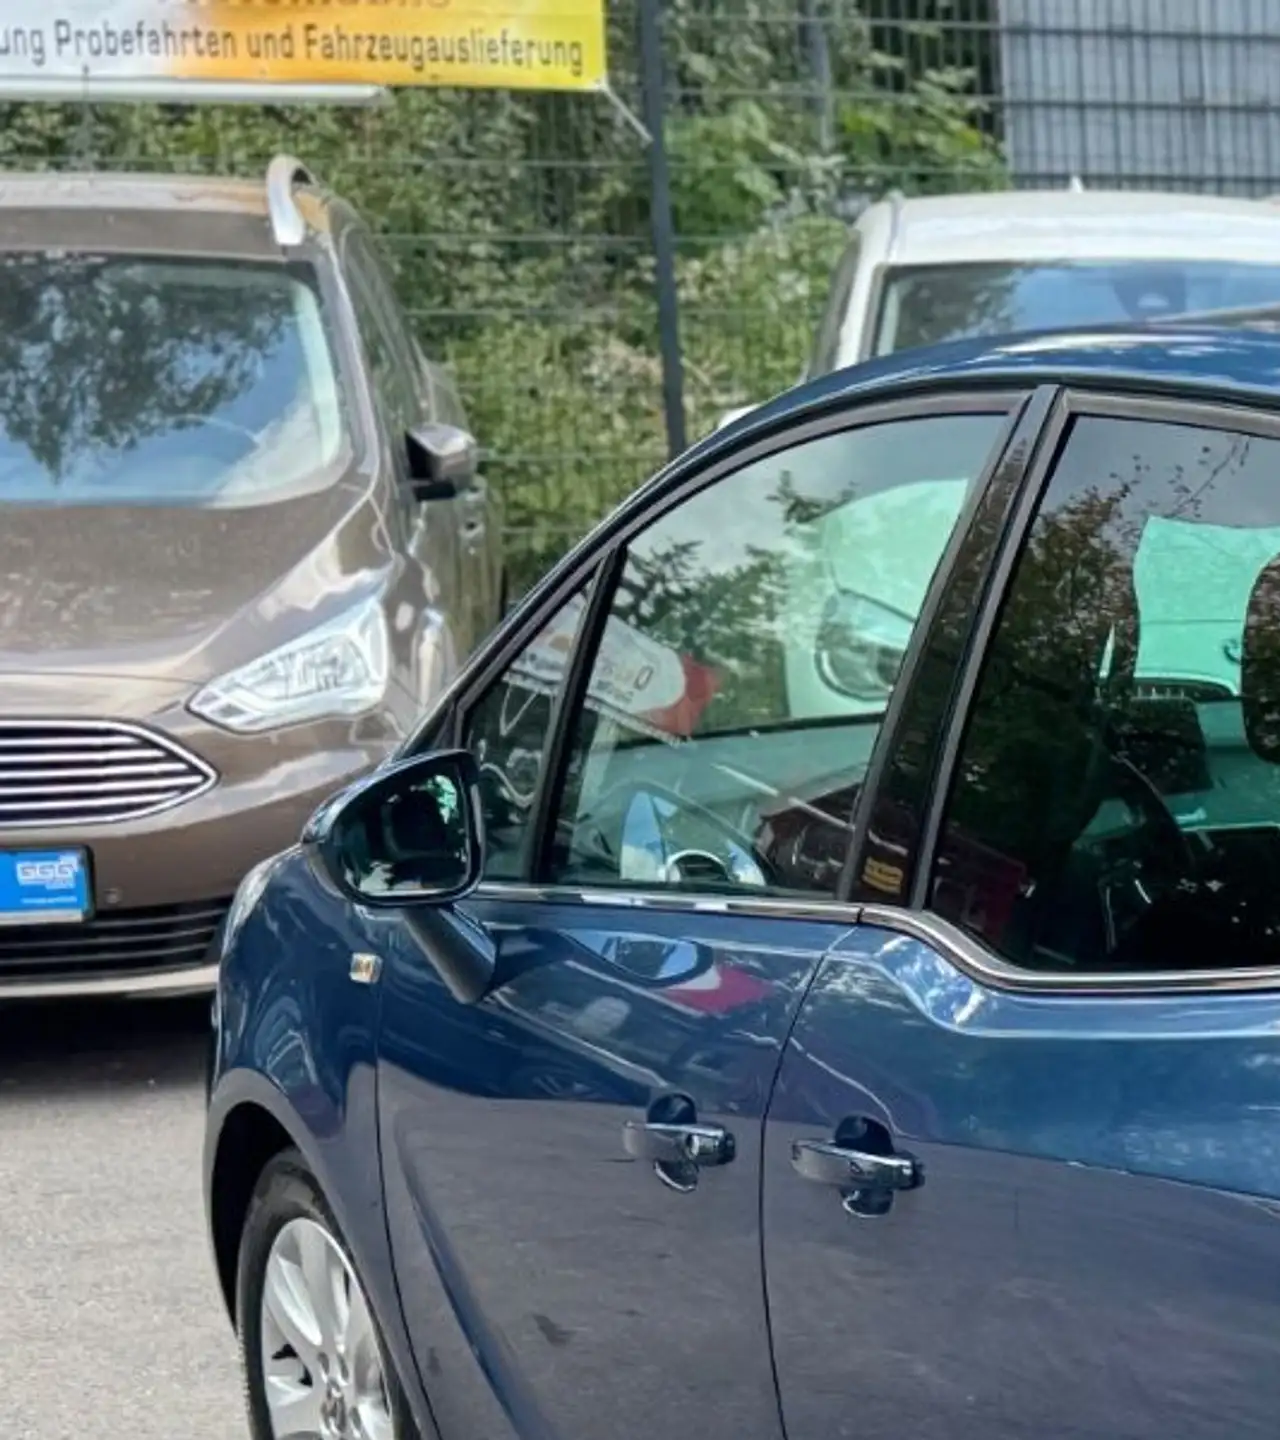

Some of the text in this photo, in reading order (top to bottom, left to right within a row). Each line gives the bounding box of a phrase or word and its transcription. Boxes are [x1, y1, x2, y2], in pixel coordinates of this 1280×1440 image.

[53, 18, 238, 59] Probefahrten
[246, 23, 295, 59] und
[304, 22, 583, 78] Fahrzeugauslieferung
